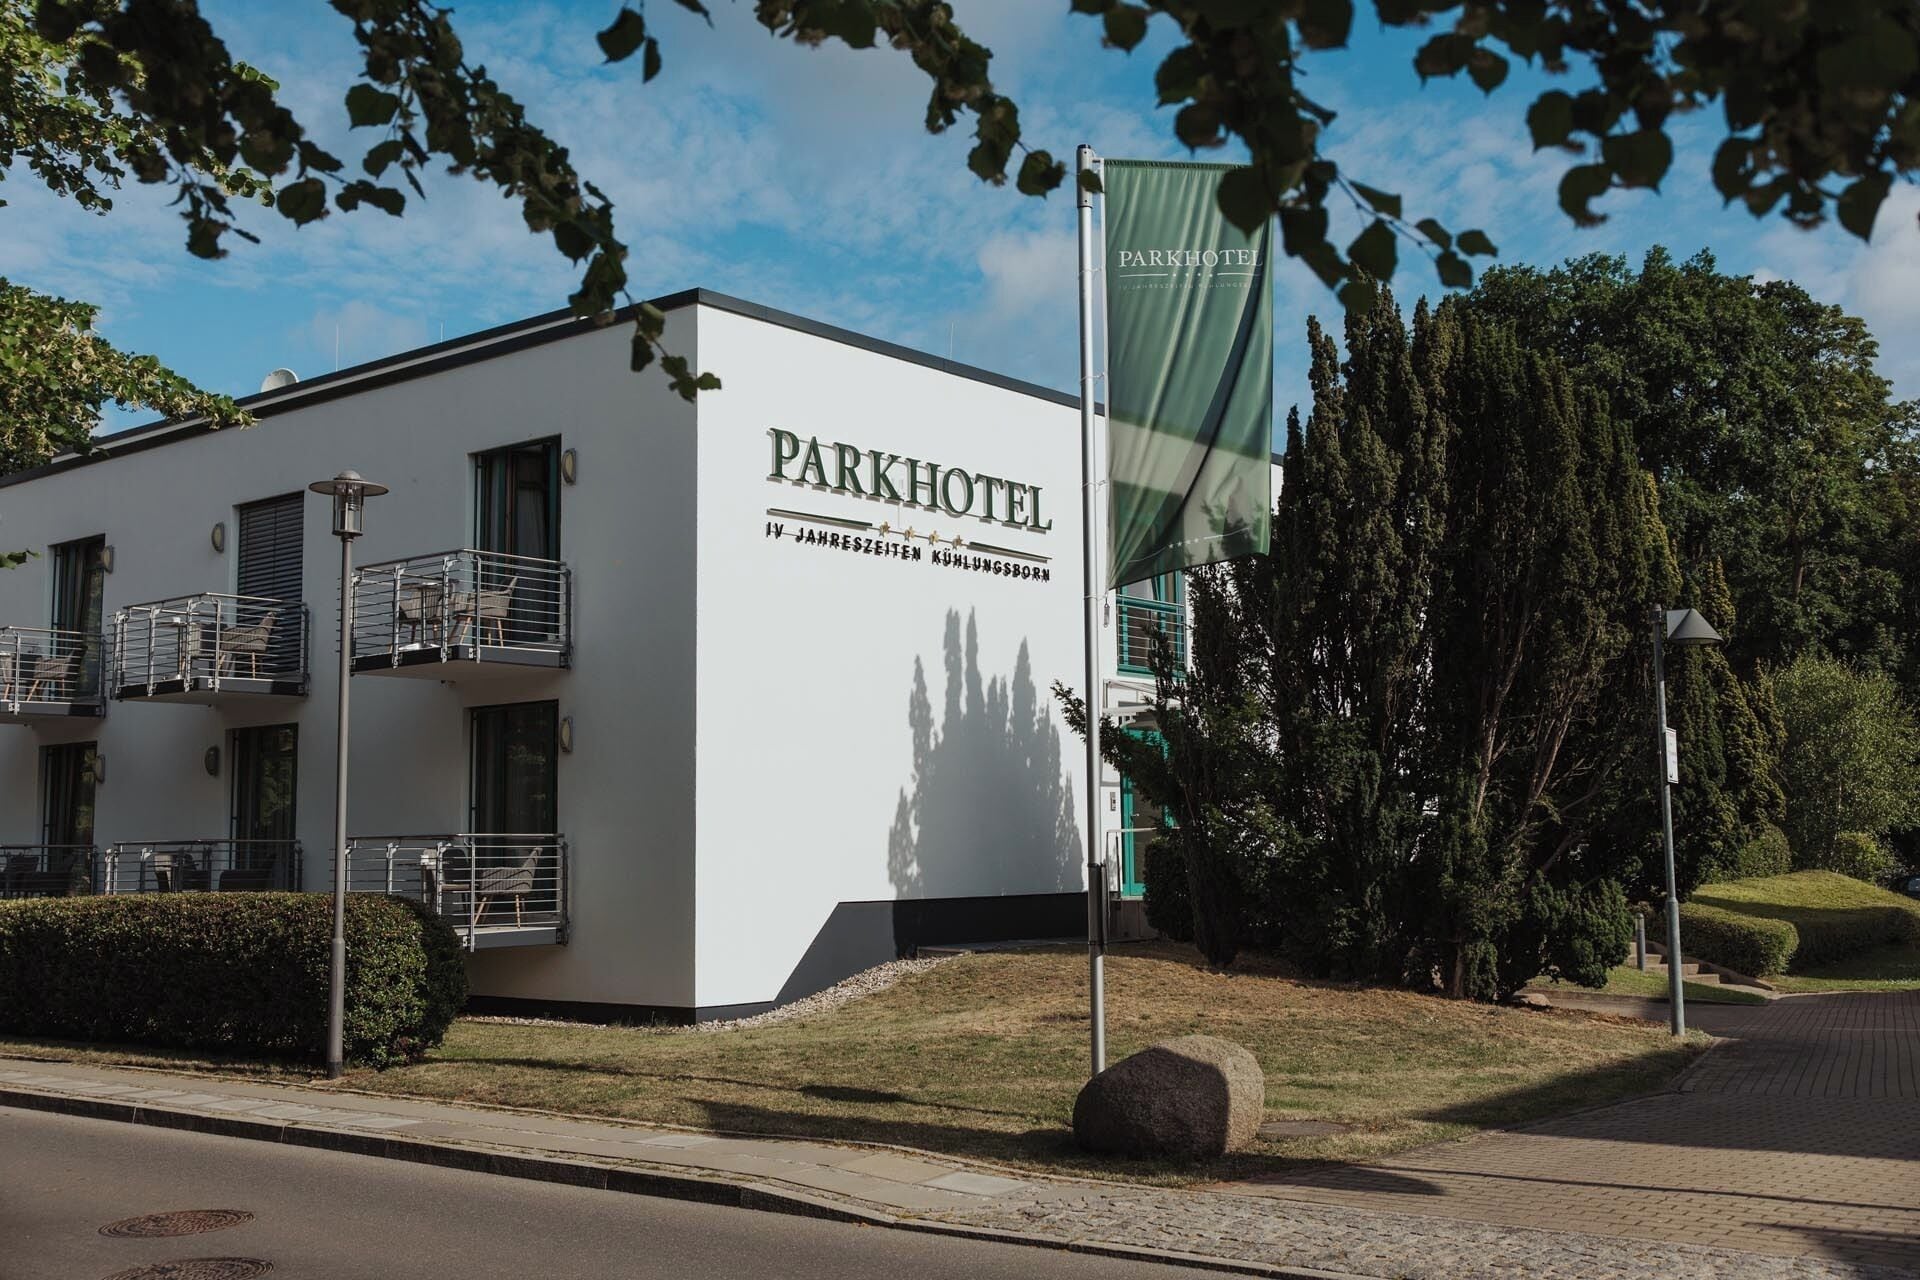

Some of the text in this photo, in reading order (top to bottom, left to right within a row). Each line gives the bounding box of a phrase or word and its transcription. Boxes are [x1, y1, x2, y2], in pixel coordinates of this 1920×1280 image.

[1119, 249, 1263, 267] PARKHOTEL
[767, 427, 1052, 531] PARKHOTEL
[766, 521, 1050, 582] IV JAHRESZEITEN KÜHLUNGSBORN
